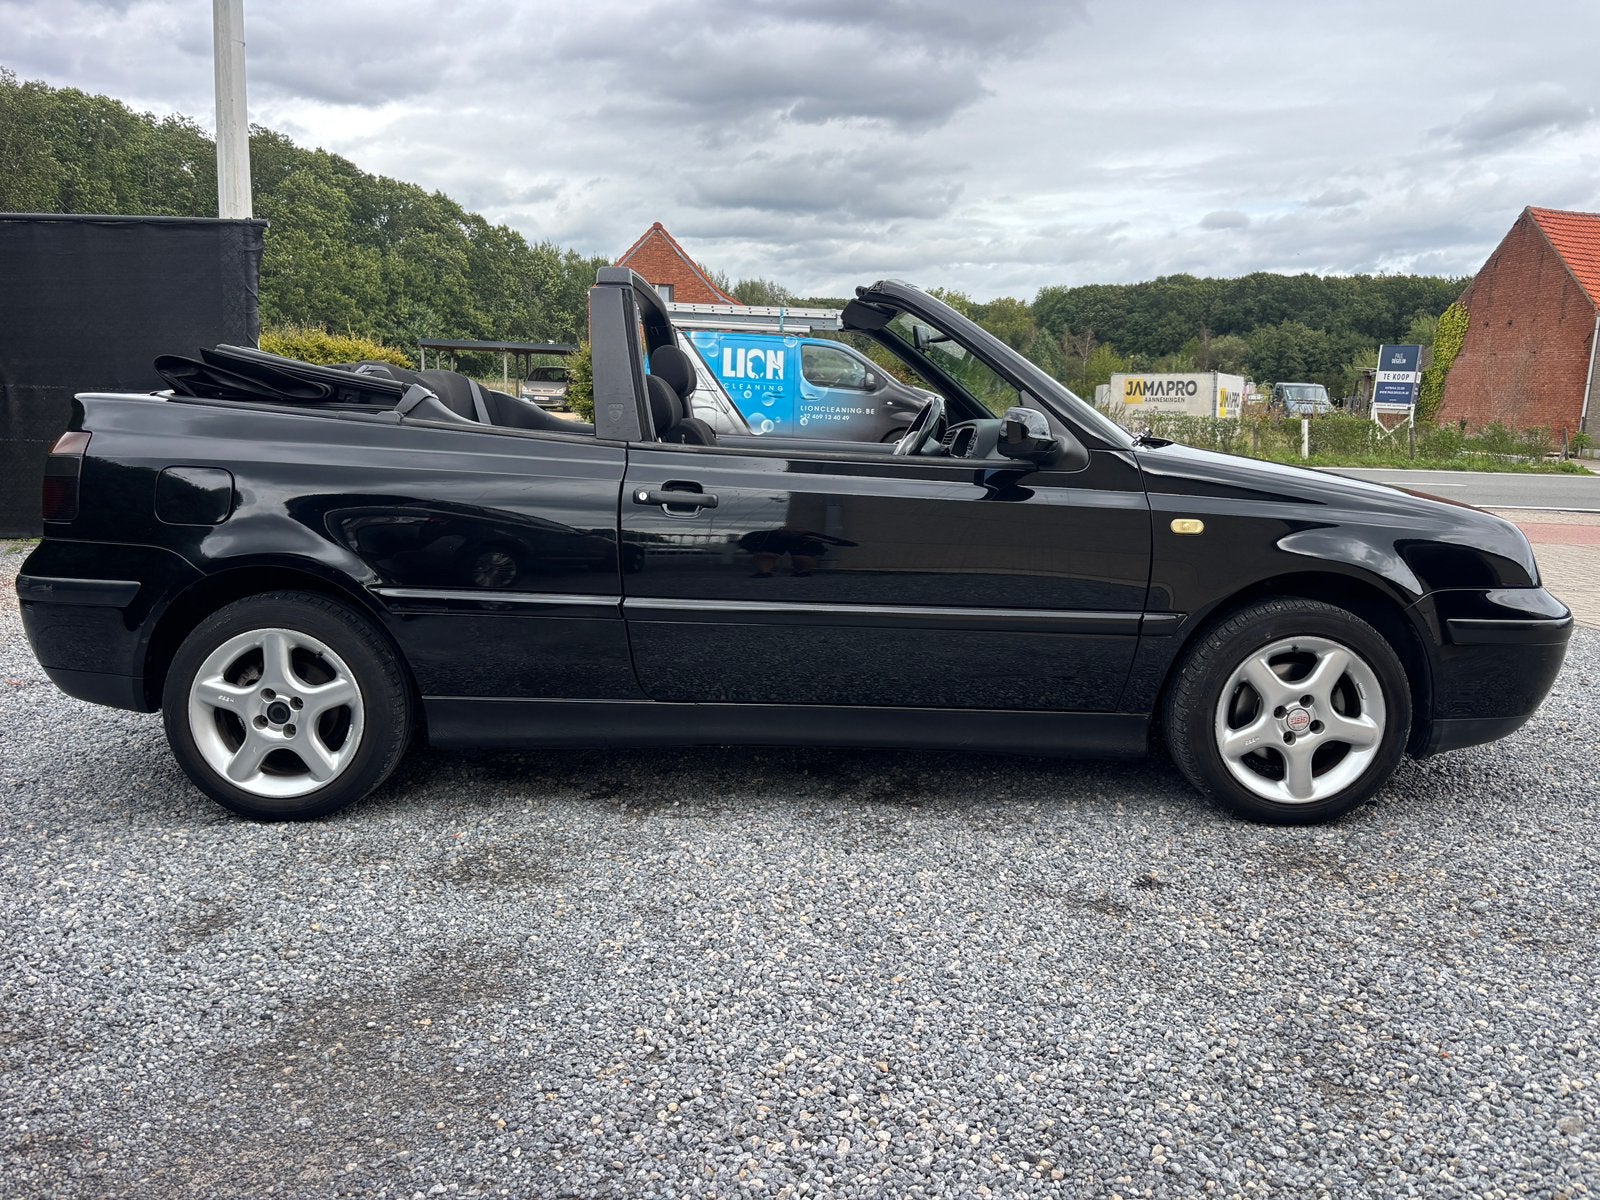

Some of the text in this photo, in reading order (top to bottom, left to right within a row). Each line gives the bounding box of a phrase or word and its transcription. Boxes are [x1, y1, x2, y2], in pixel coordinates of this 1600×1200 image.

[722, 347, 785, 380] LION
[1392, 373, 1410, 381] KOOP
[723, 382, 784, 392] CLEANING
[1125, 380, 1198, 397] JAMAPRO
[800, 405, 876, 415] LIONCLEANING.BE
